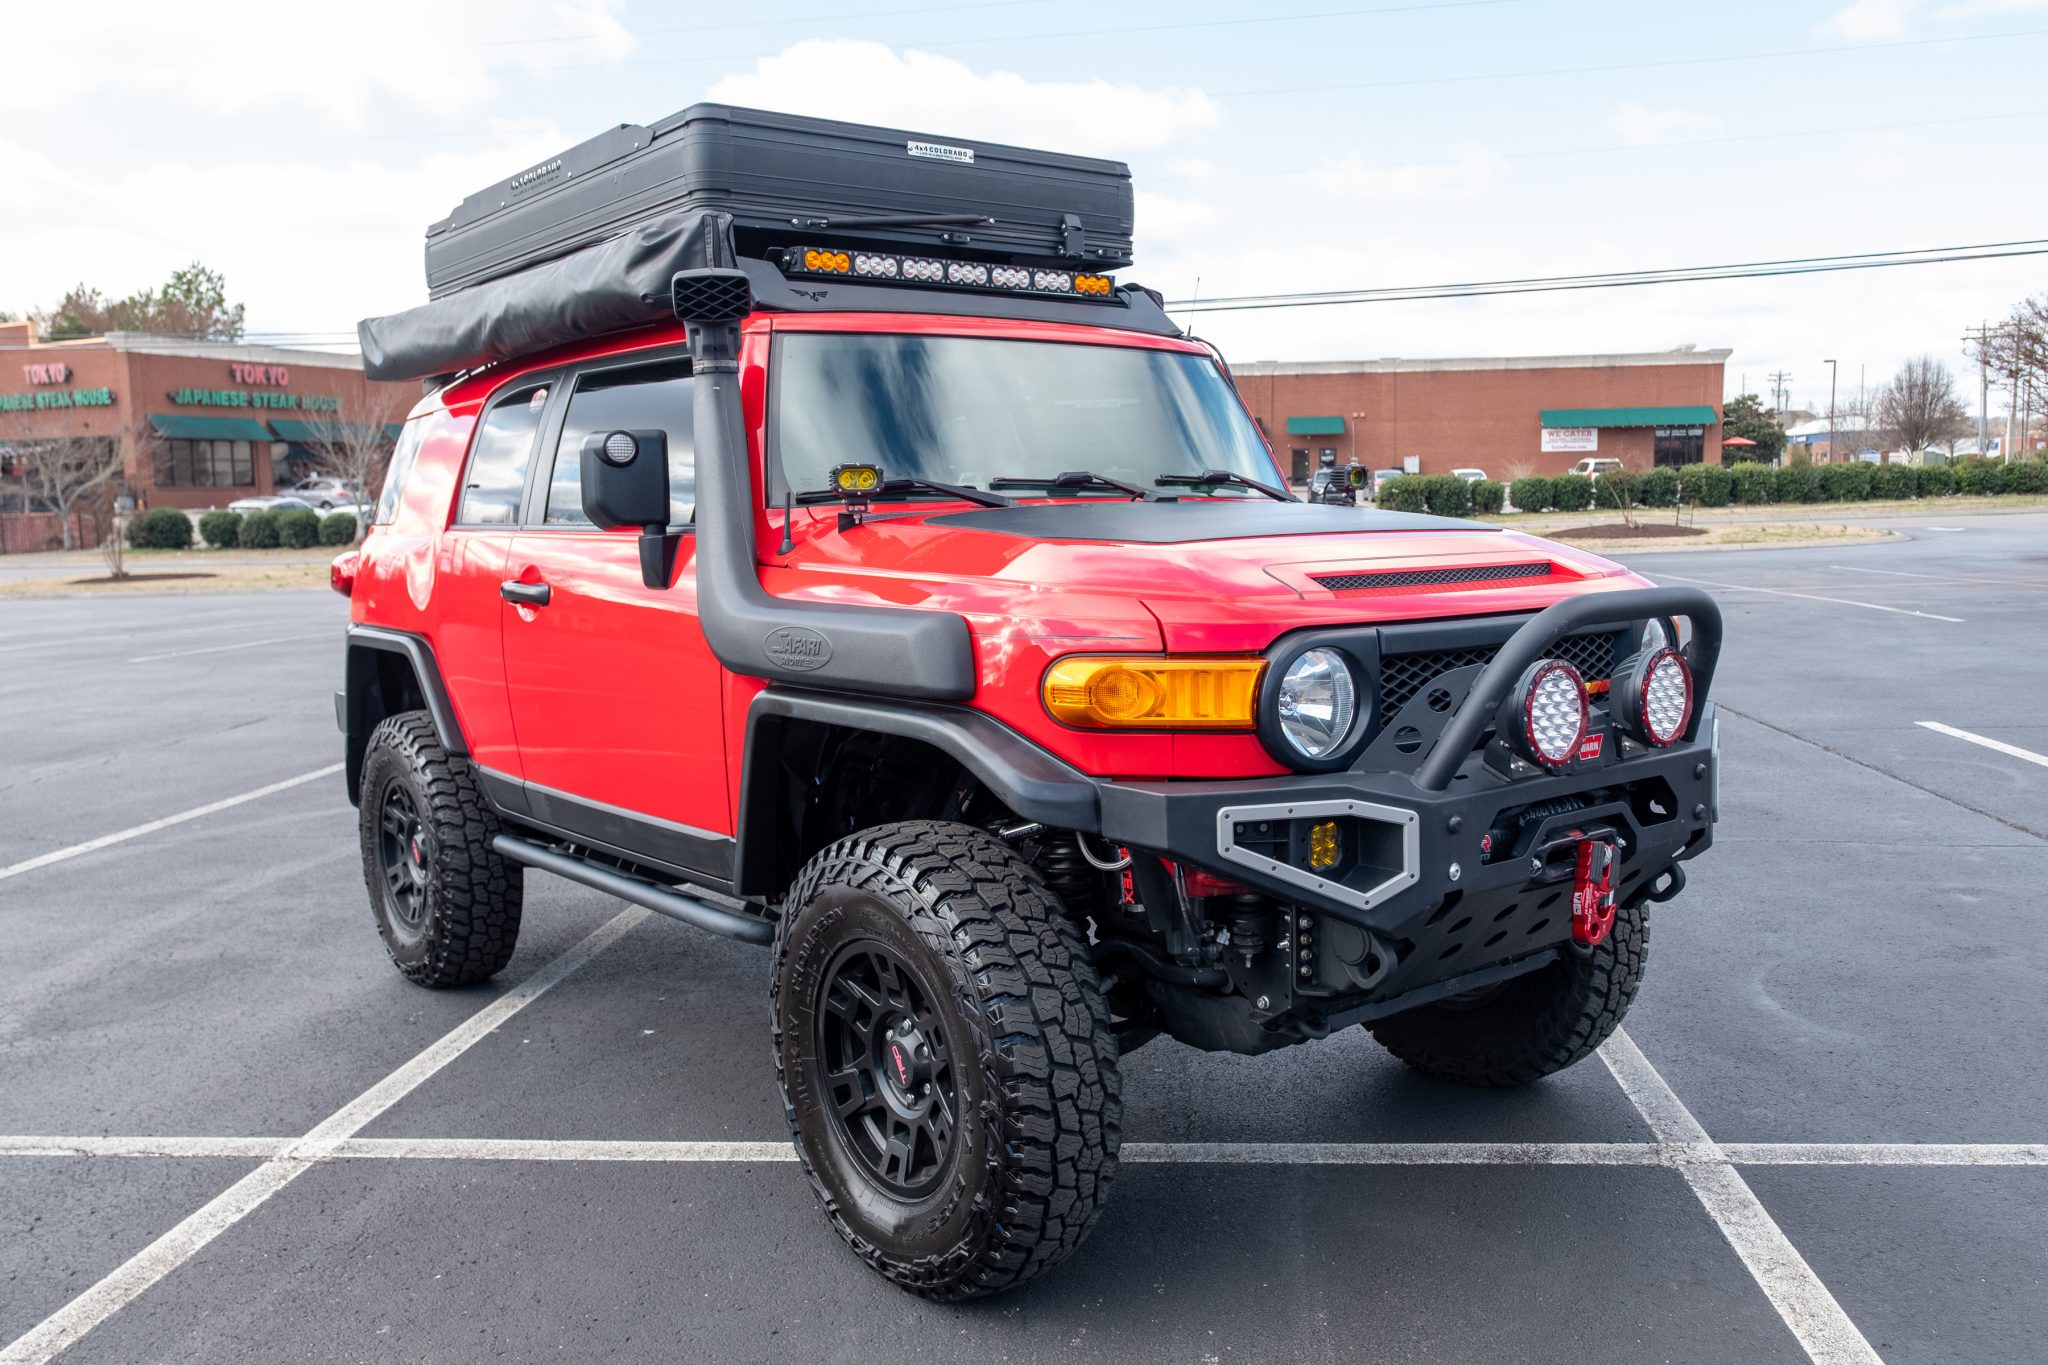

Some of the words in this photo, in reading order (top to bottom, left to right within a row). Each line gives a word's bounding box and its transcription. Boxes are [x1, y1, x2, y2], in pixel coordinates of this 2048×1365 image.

[23, 363, 66, 384] TOKYO
[232, 364, 289, 386] TOKYO
[175, 388, 248, 407] JAPANESE
[252, 392, 297, 410] STEAK
[1547, 430, 1561, 438] WE
[1563, 429, 1593, 438] CATER
[771, 631, 822, 656] SAFARI
